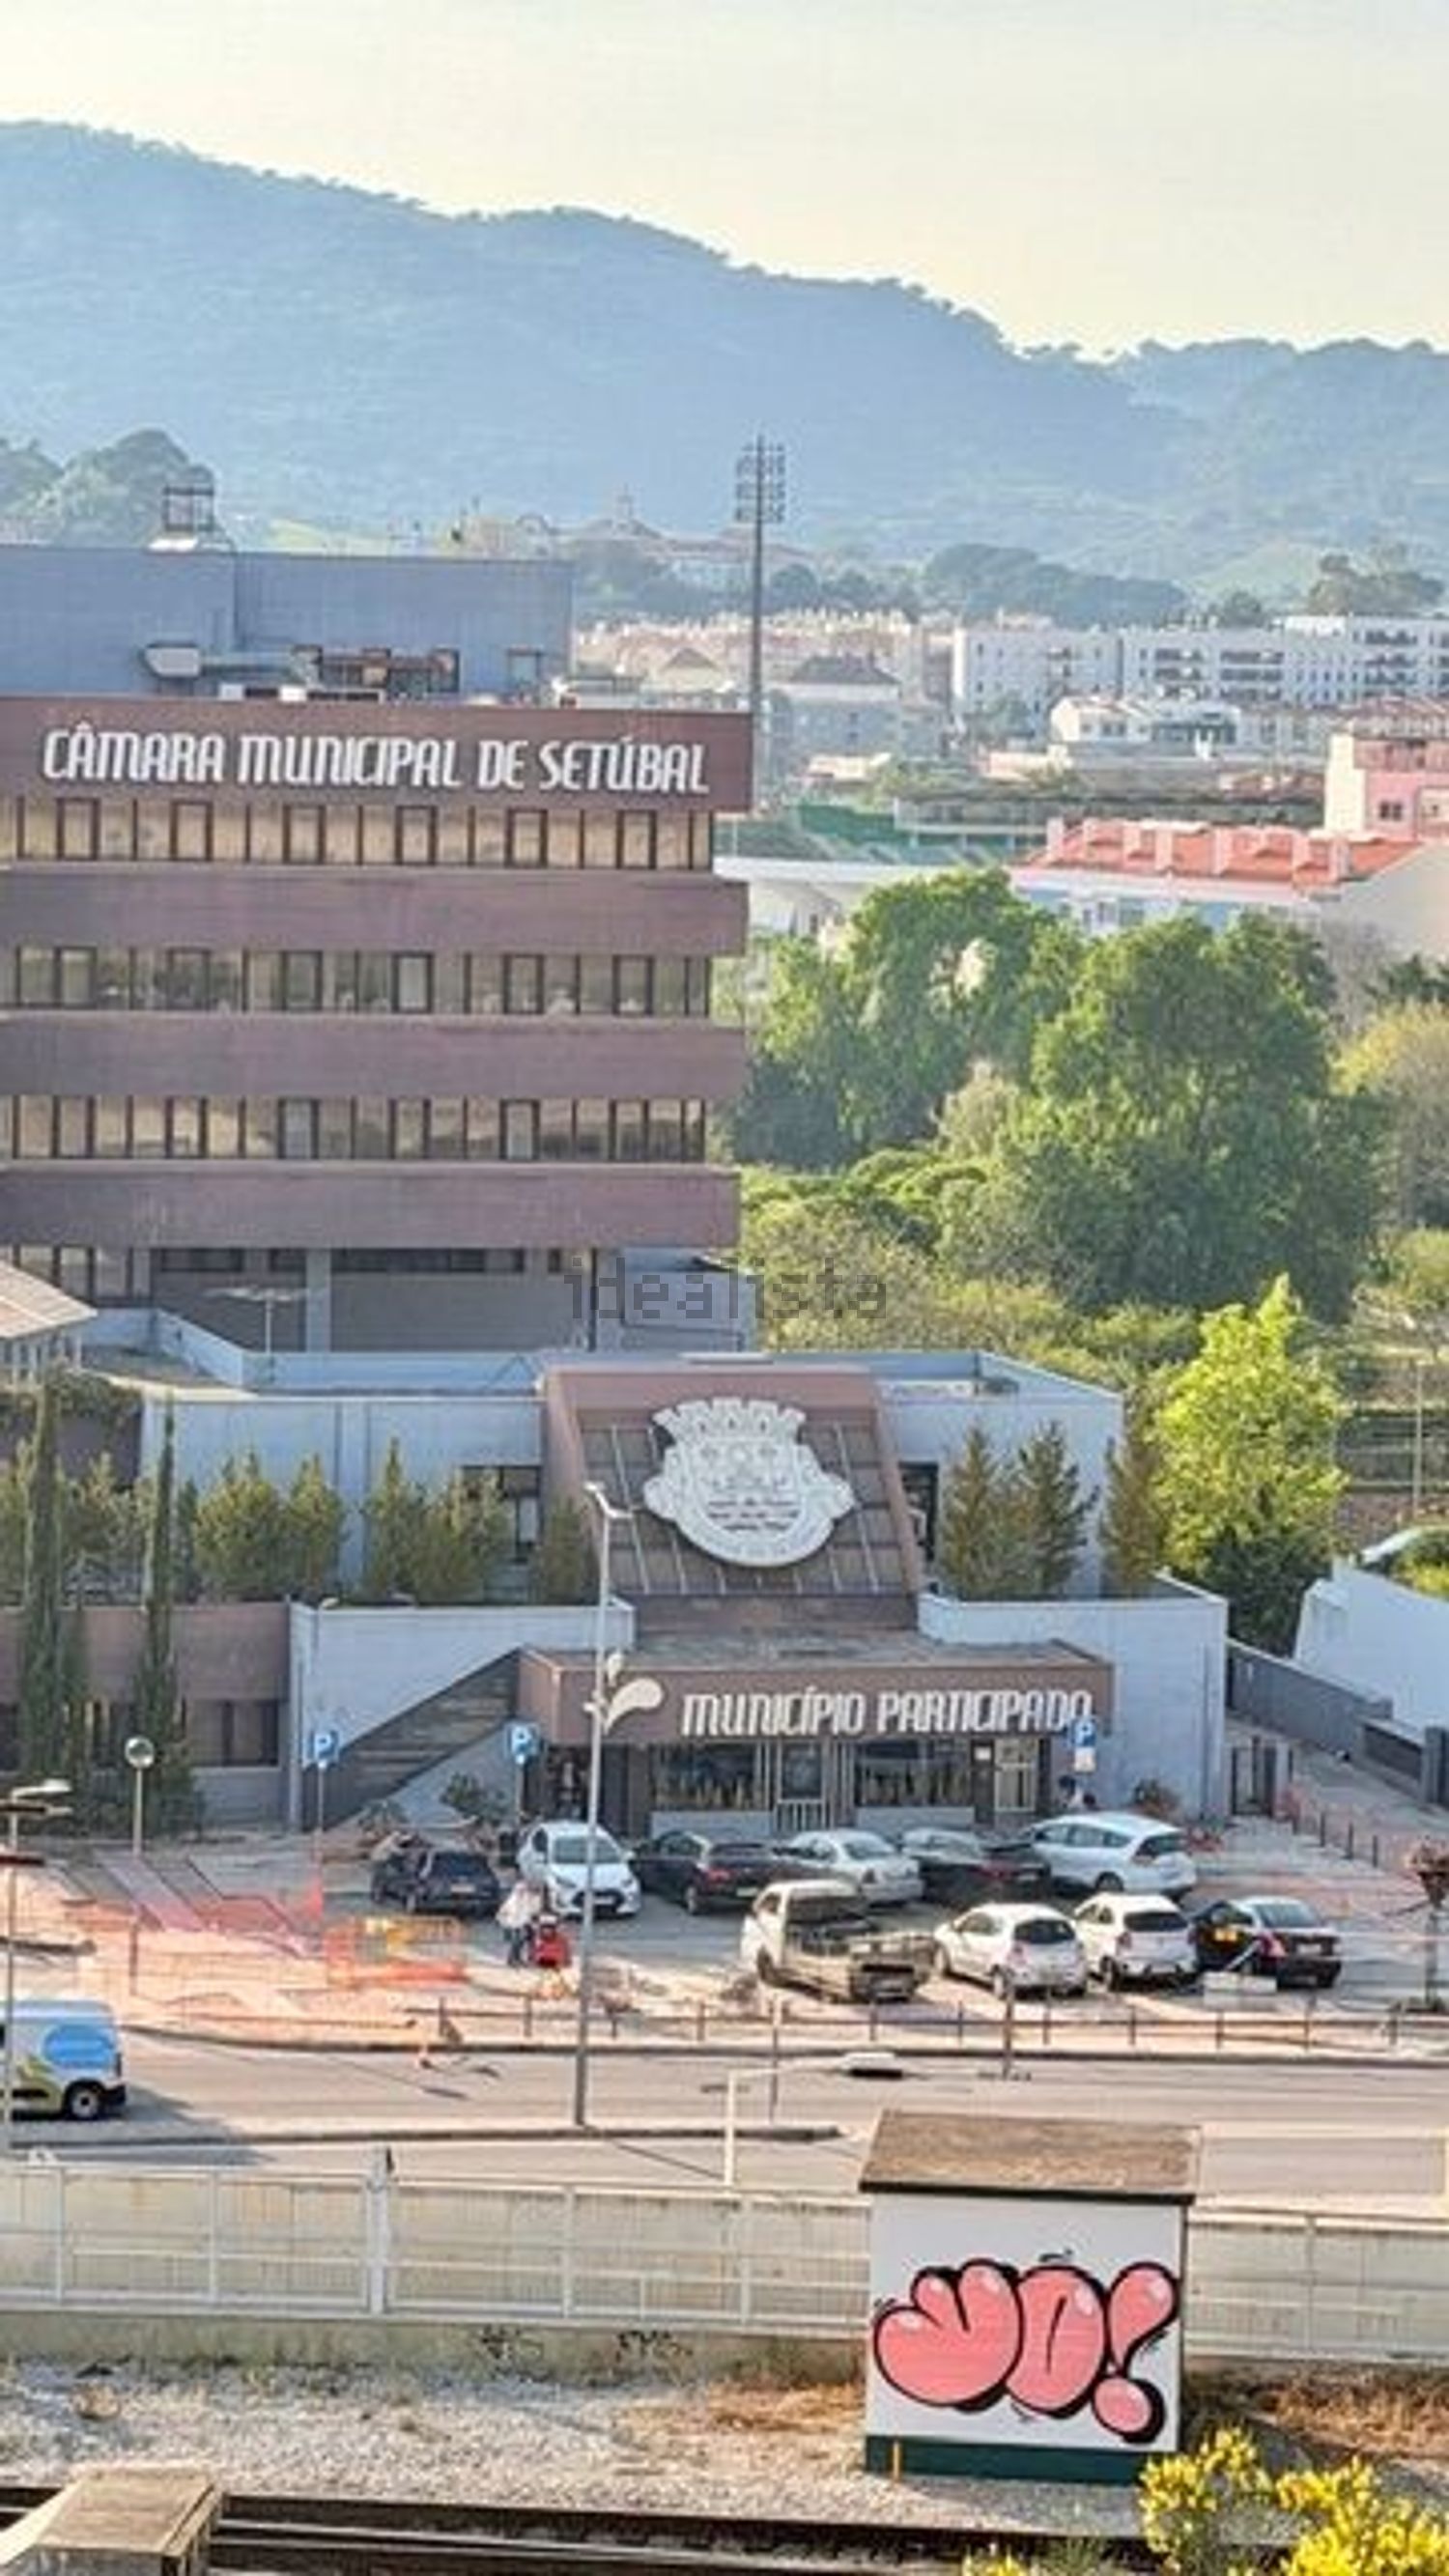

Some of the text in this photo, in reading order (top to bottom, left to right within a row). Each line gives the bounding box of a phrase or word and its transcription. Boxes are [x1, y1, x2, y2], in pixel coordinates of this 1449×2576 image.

[43, 722, 710, 794] CÂMARA MUNICIPAL DE SETÚBAL
[681, 1685, 1093, 1737] MUNICÍPIO PARTICIPADO
[1074, 1719, 1094, 1744] P
